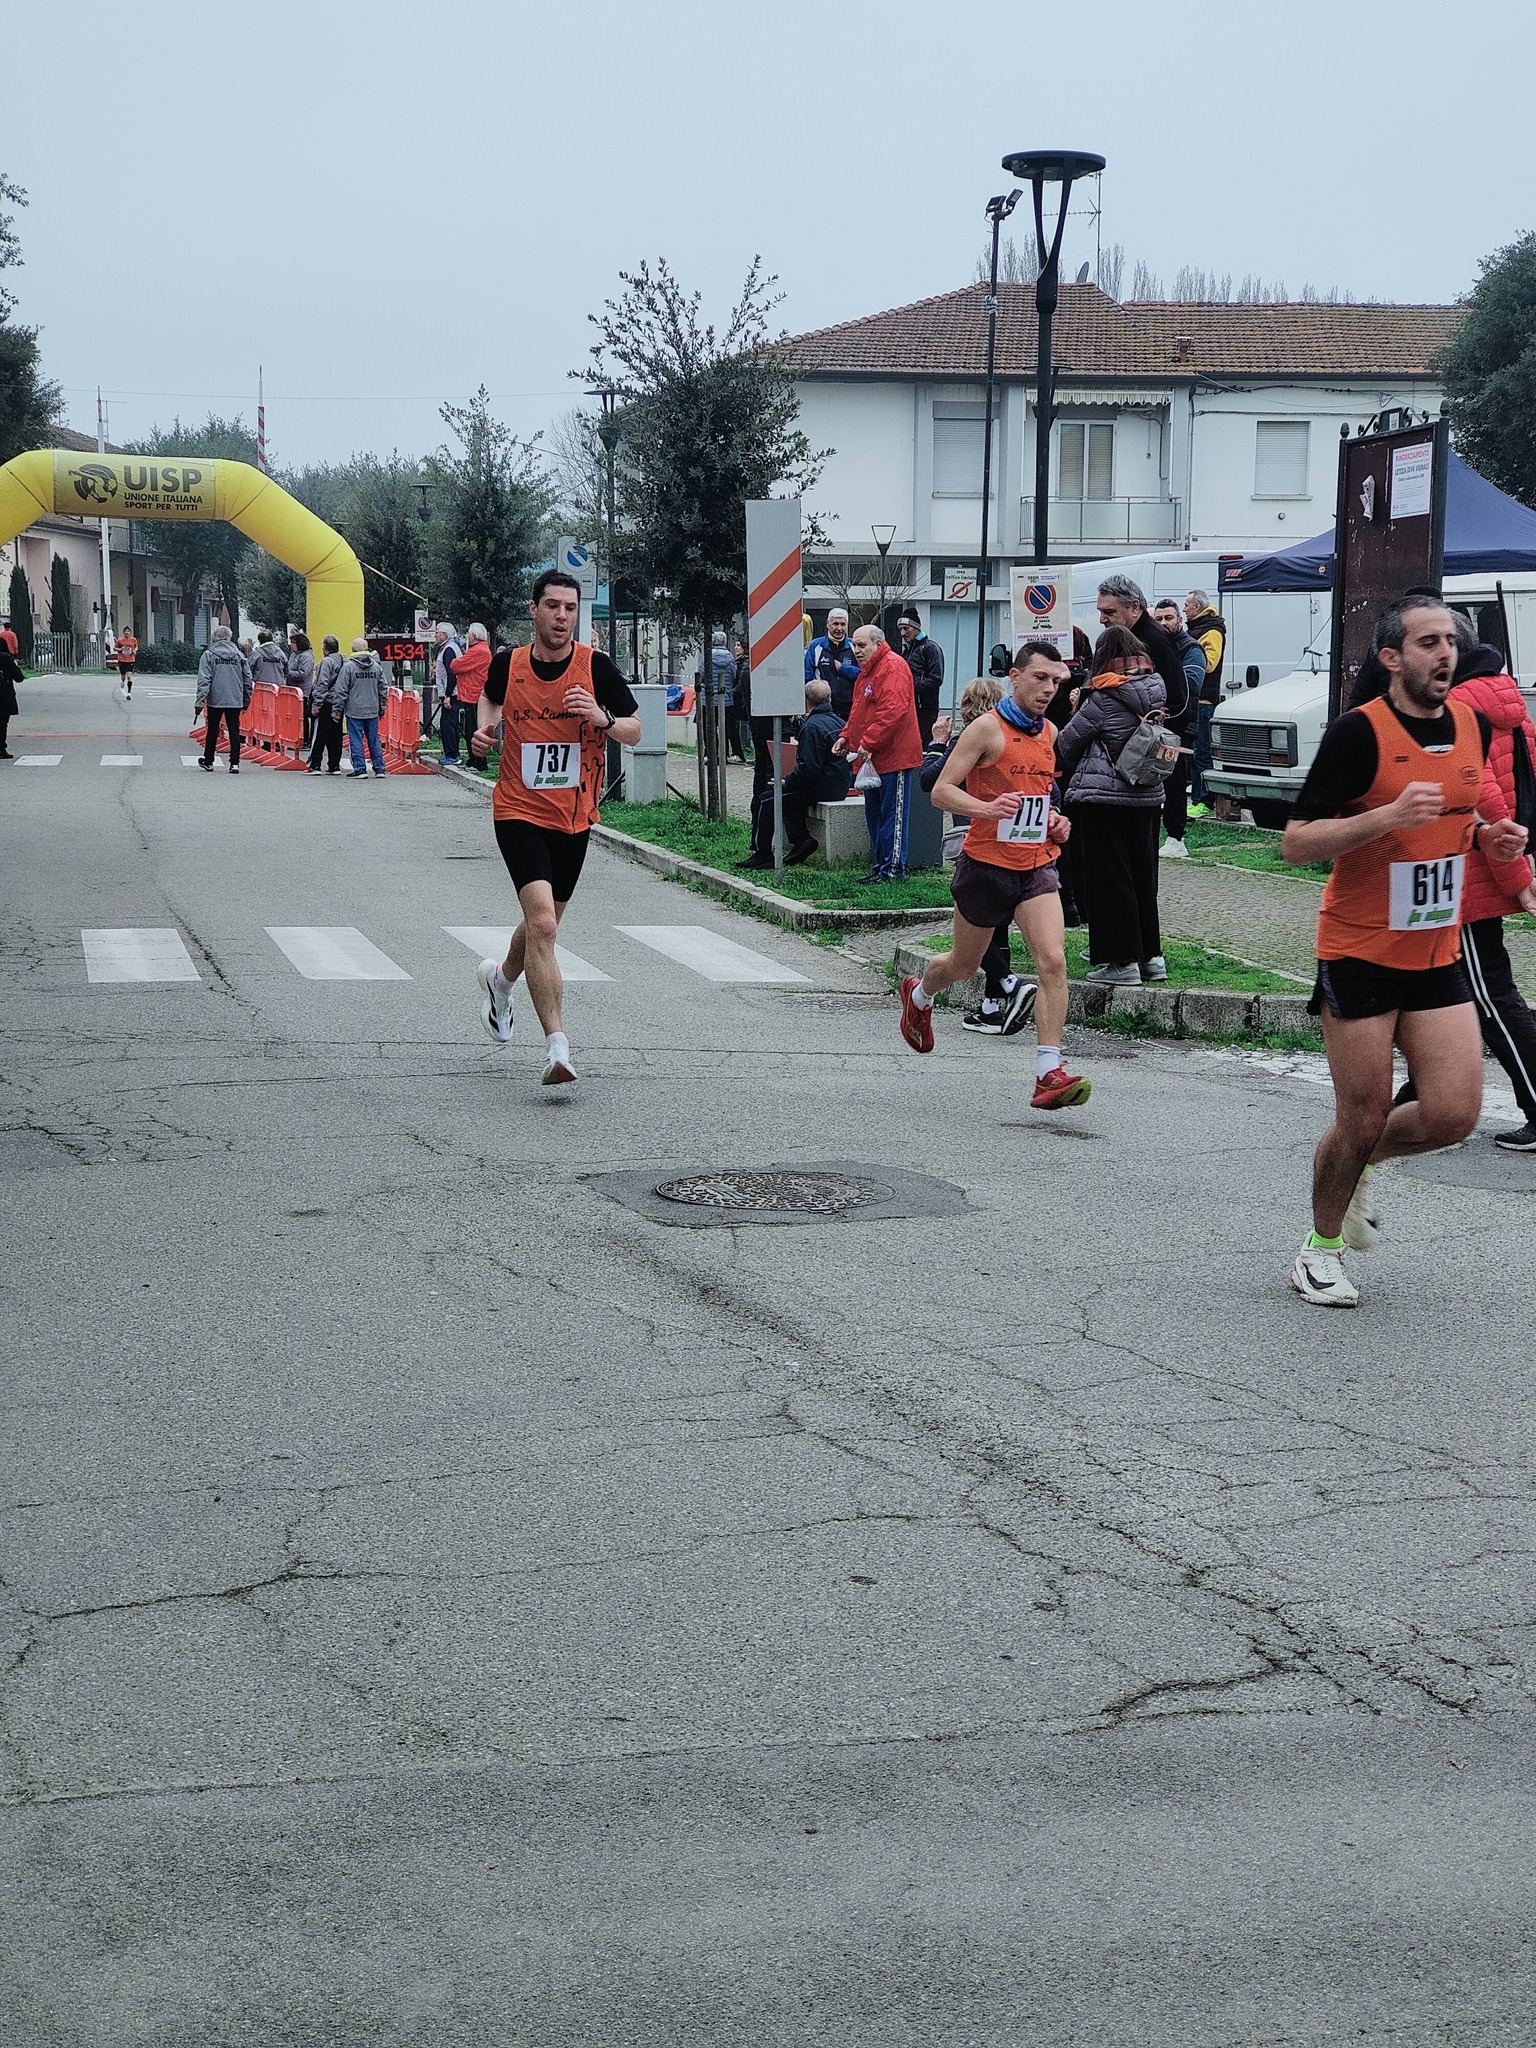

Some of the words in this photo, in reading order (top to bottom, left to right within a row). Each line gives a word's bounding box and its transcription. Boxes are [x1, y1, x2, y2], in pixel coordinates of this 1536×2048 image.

[123, 465, 202, 493] UISP
[124, 492, 160, 502] UNIONE
[163, 494, 203, 504] ITALIANA
[124, 501, 152, 510] SPORT
[156, 502, 171, 511] PER
[175, 503, 198, 511] TUTTI
[355, 671, 377, 680] GIUDICE
[535, 744, 571, 774] 737
[1013, 797, 1043, 827] 772
[1413, 859, 1454, 906] 614
